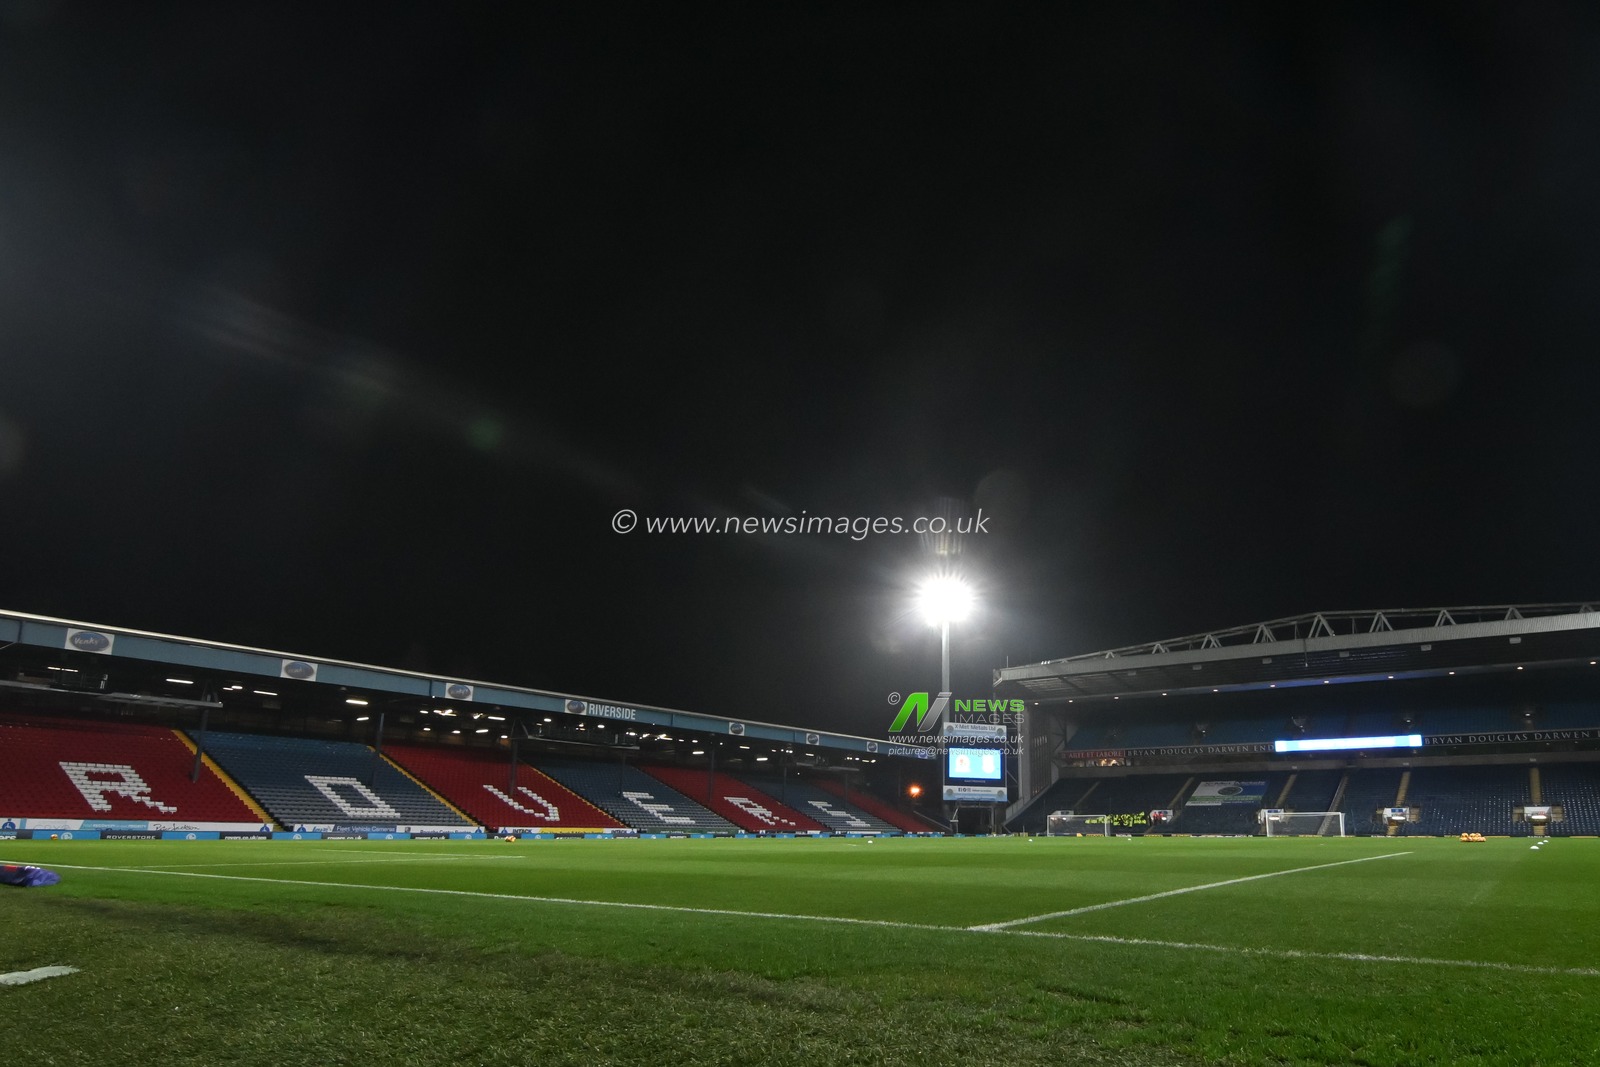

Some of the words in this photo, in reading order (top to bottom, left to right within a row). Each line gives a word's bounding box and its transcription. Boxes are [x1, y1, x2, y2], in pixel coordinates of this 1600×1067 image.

[588, 702, 636, 720] RIVERSIDE
[1424, 735, 1462, 745] BRYAN
[1469, 732, 1528, 743] DOUGLAS
[1534, 731, 1590, 740] DARWEN
[1128, 749, 1156, 757] BRYAN
[1160, 747, 1204, 756] DOUGLAS
[1208, 745, 1249, 754] DARWEN
